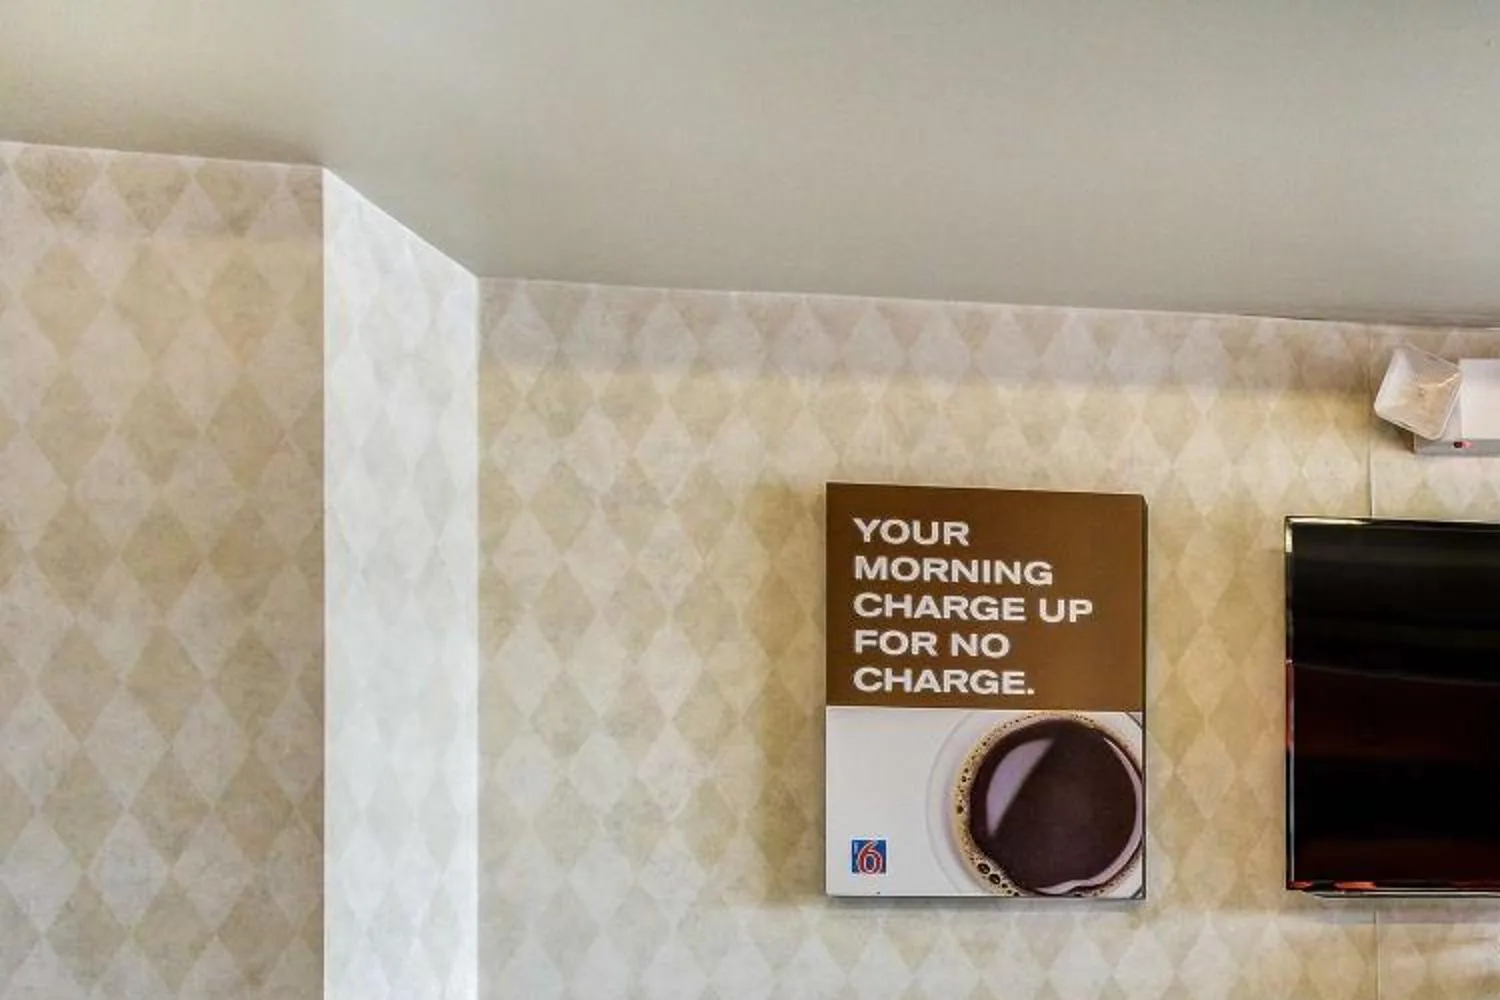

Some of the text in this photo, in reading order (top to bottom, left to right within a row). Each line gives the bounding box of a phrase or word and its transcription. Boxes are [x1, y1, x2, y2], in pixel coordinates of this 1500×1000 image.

[853, 517, 970, 547] YOUR
[854, 555, 1053, 586] MORNING
[853, 592, 1093, 623] CHARGE UP
[854, 629, 1011, 659] FOR NO
[853, 666, 1035, 696] CHARGE.
[856, 840, 883, 875] 6
